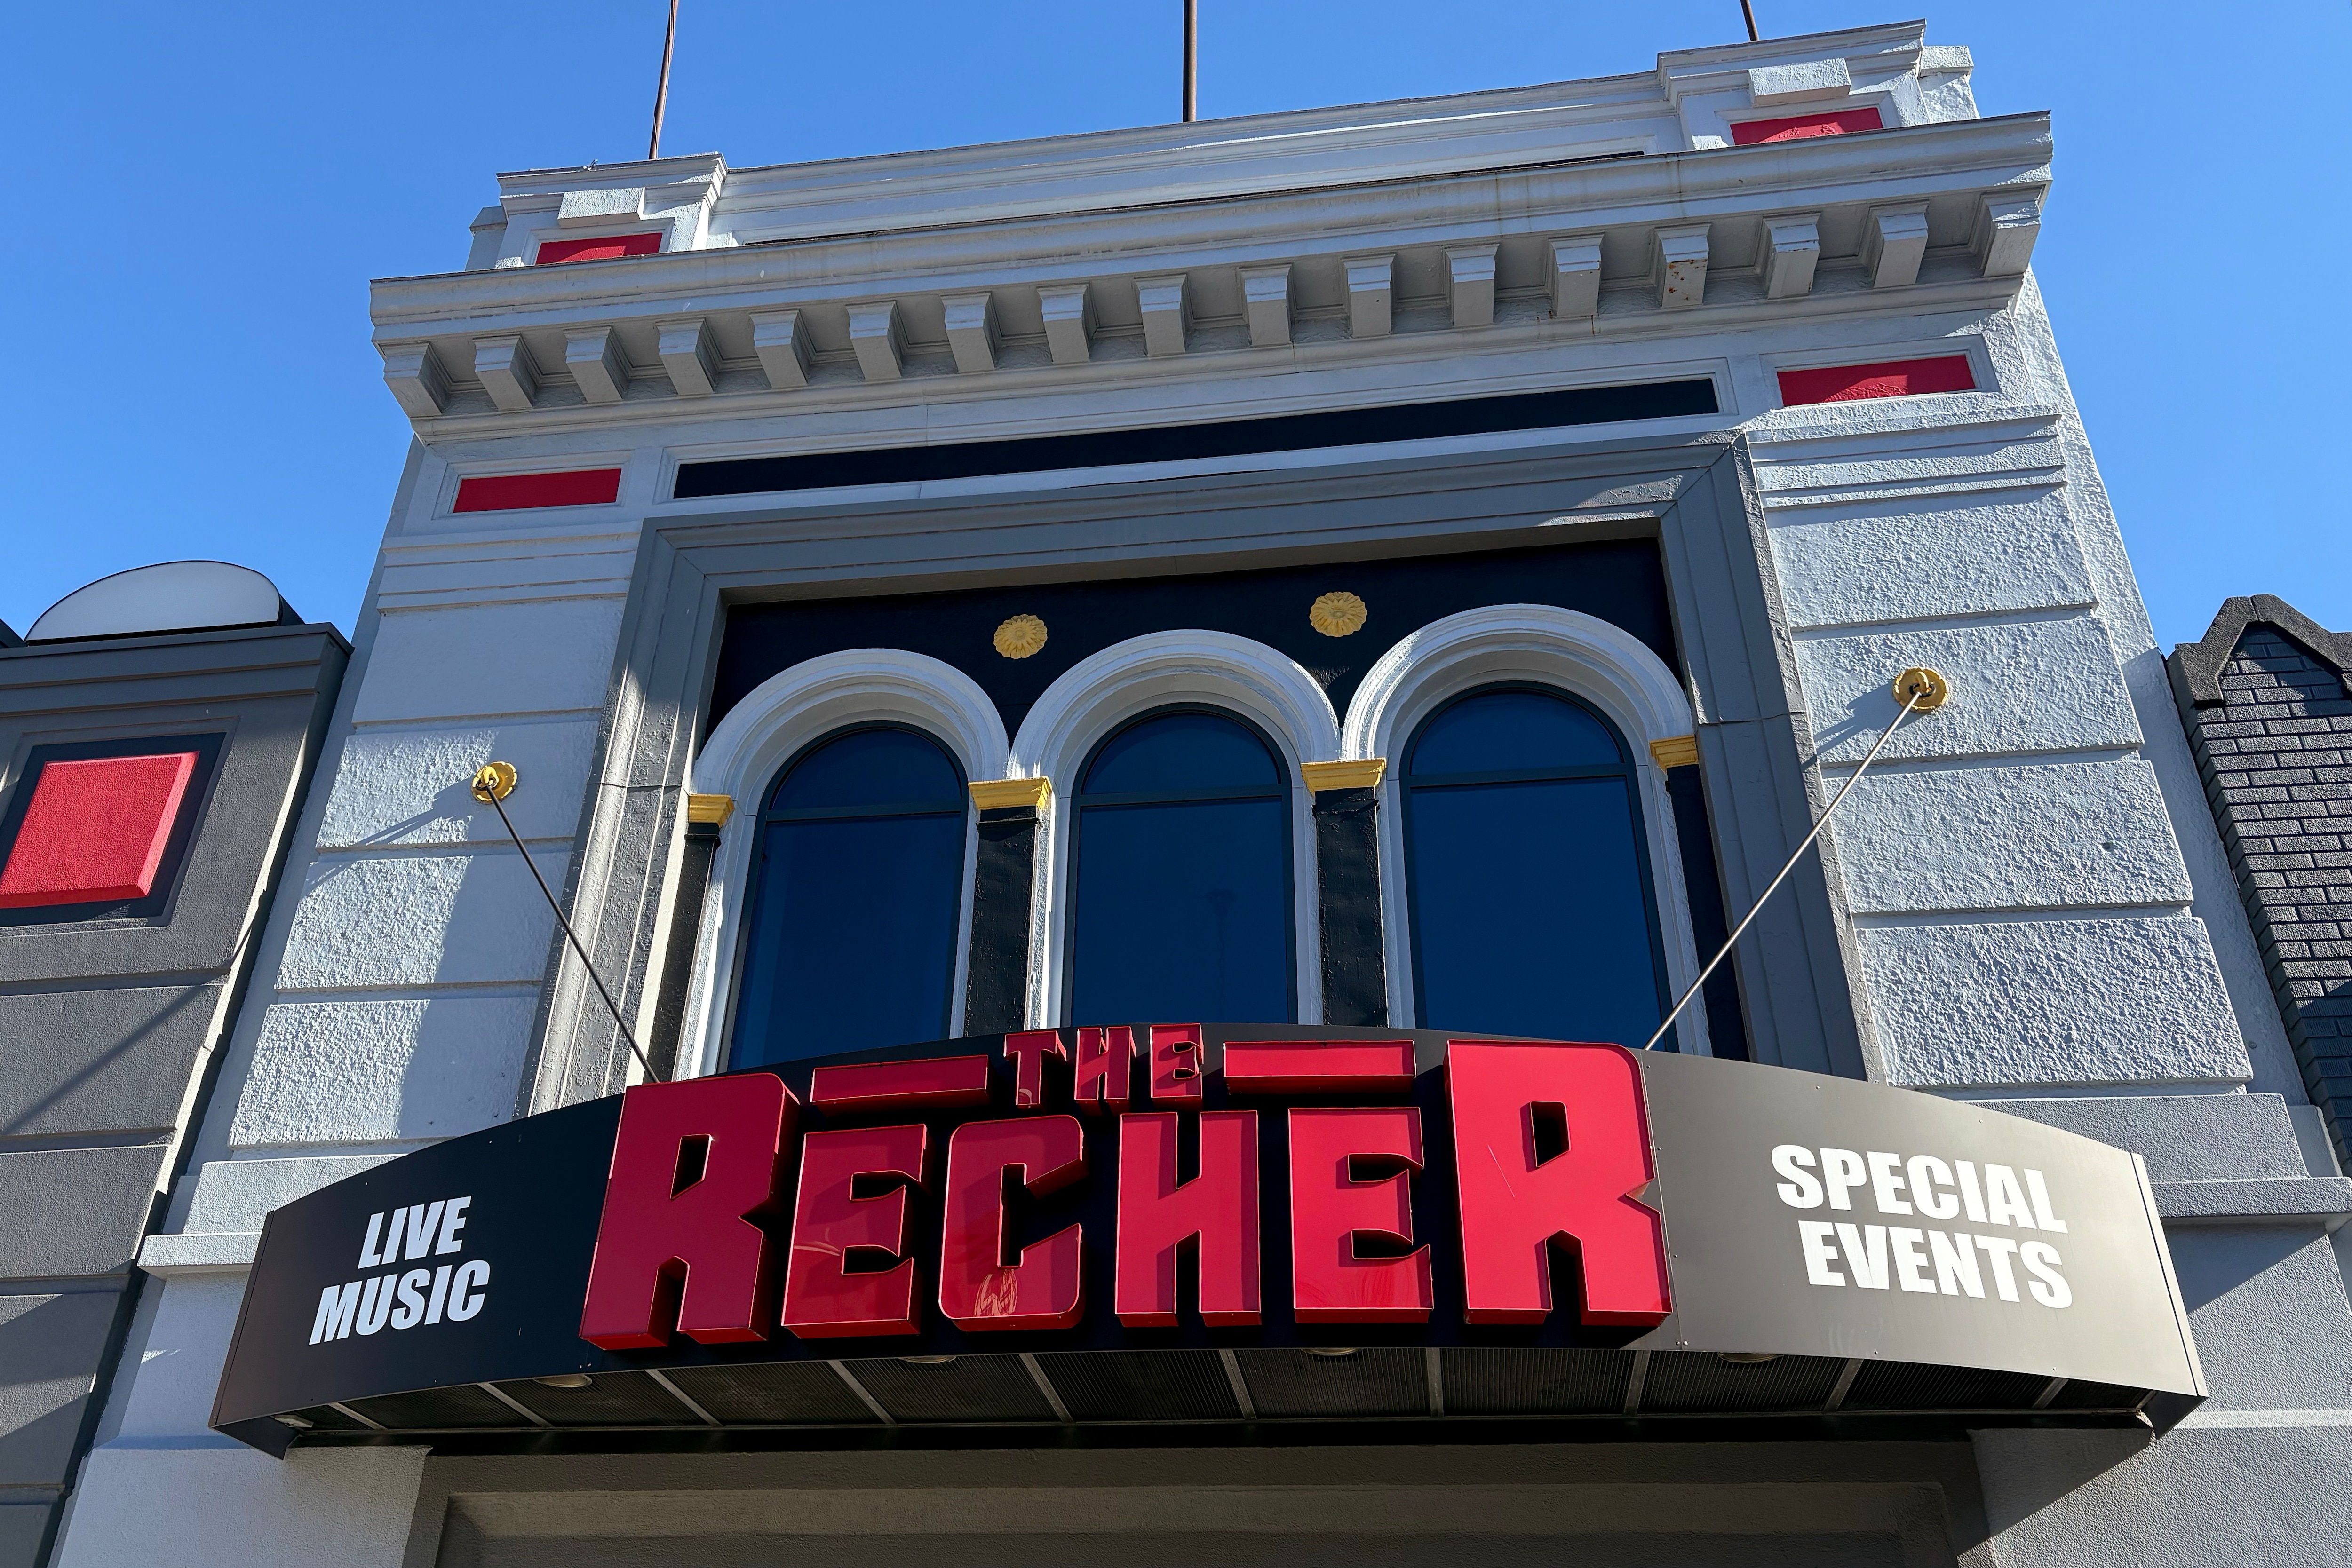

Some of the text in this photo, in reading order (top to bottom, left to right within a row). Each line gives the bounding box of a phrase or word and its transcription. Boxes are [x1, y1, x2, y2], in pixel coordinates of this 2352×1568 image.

[1005, 1024, 1203, 1112] THE
[358, 1196, 472, 1269] LIVE
[579, 1040, 1671, 1350] RECHER
[1771, 1144, 2068, 1234] SPECIAL
[309, 1260, 490, 1345] MUSIC
[1798, 1220, 2073, 1308] EVENTS
